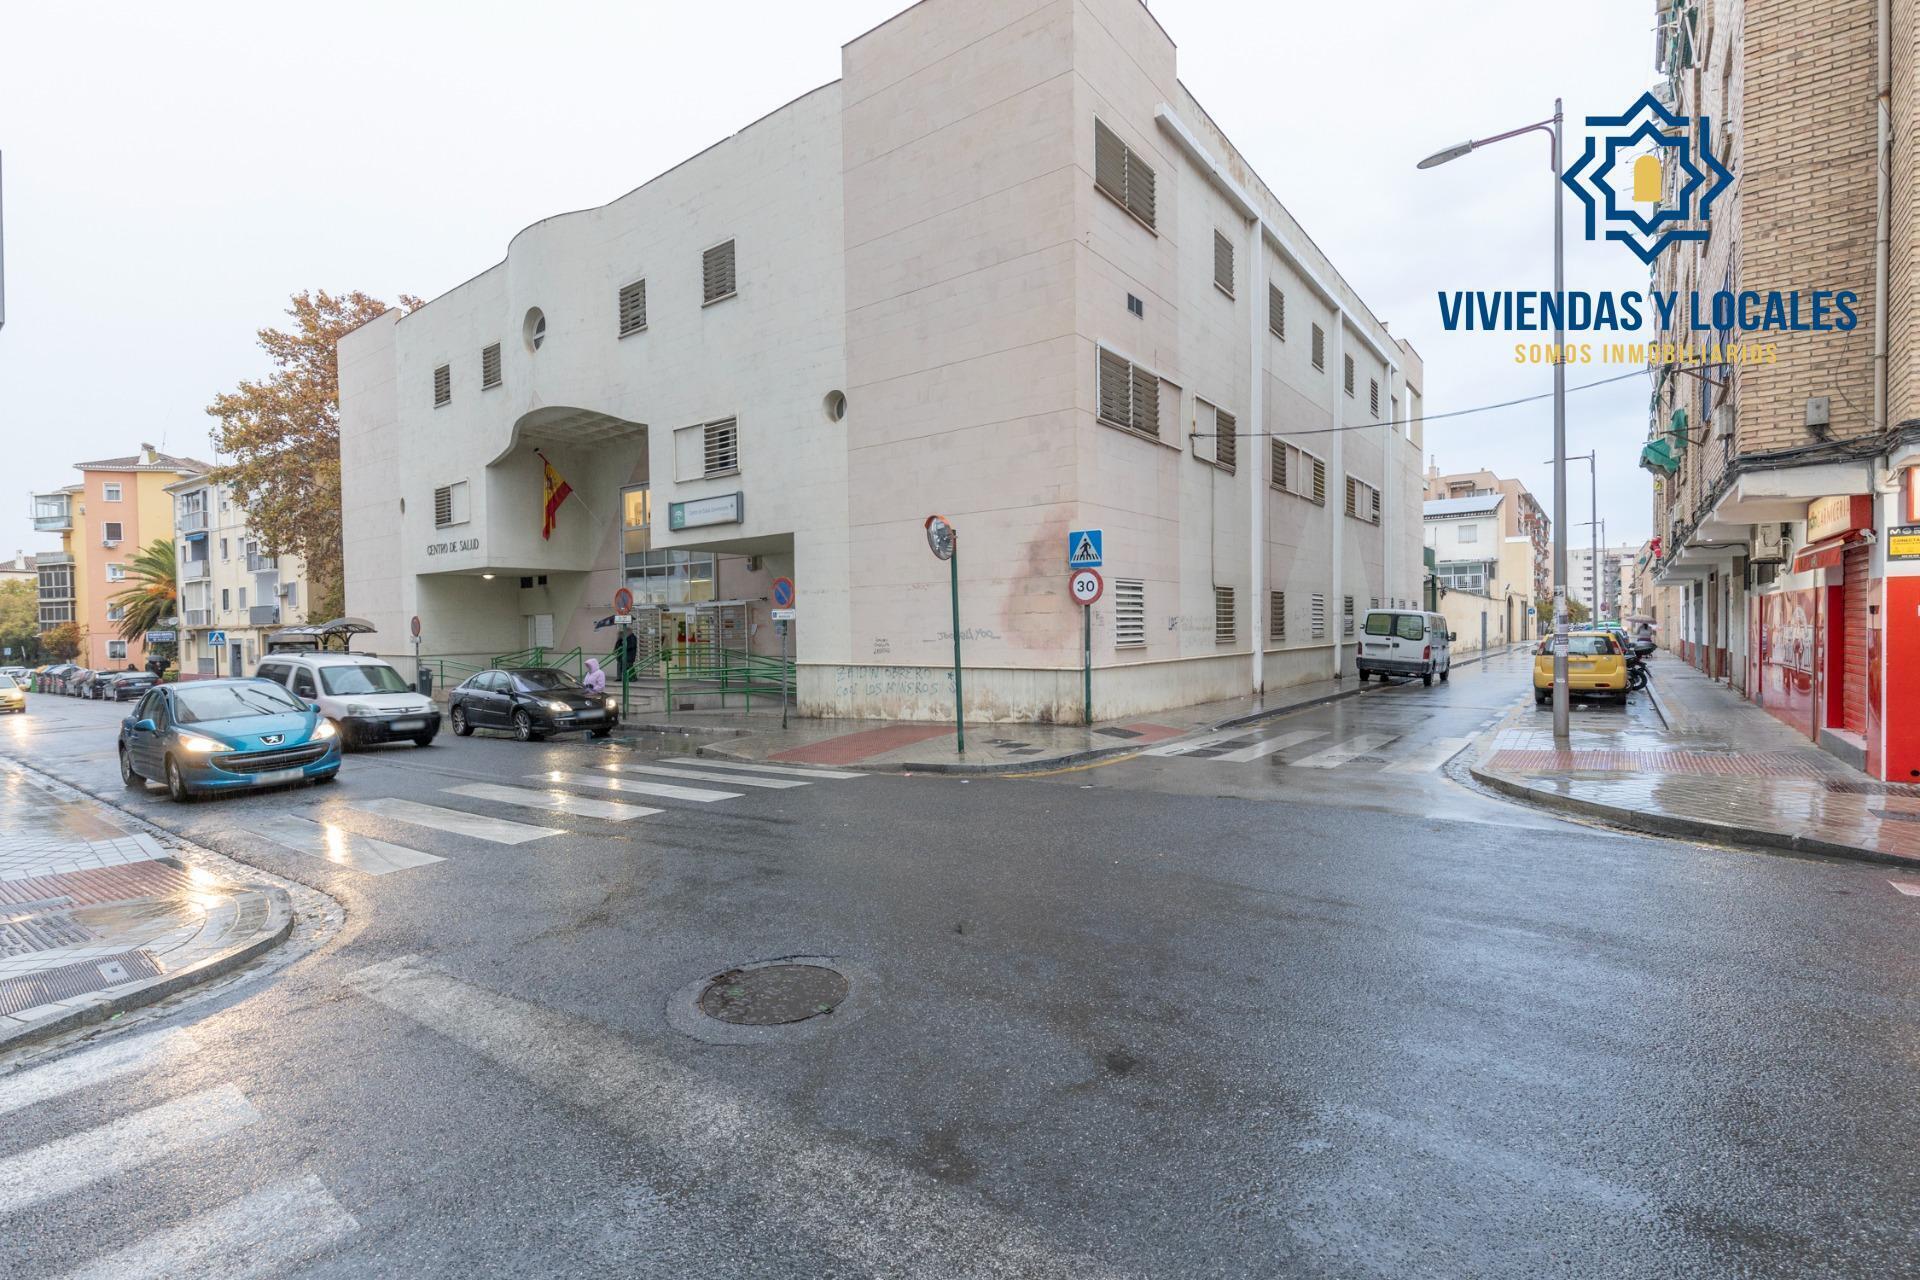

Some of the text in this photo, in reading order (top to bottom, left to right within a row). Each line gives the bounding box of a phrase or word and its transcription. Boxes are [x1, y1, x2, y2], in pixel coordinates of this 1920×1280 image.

[427, 538, 479, 555] CENTRO DE SALUD
[1077, 580, 1095, 592] 30
